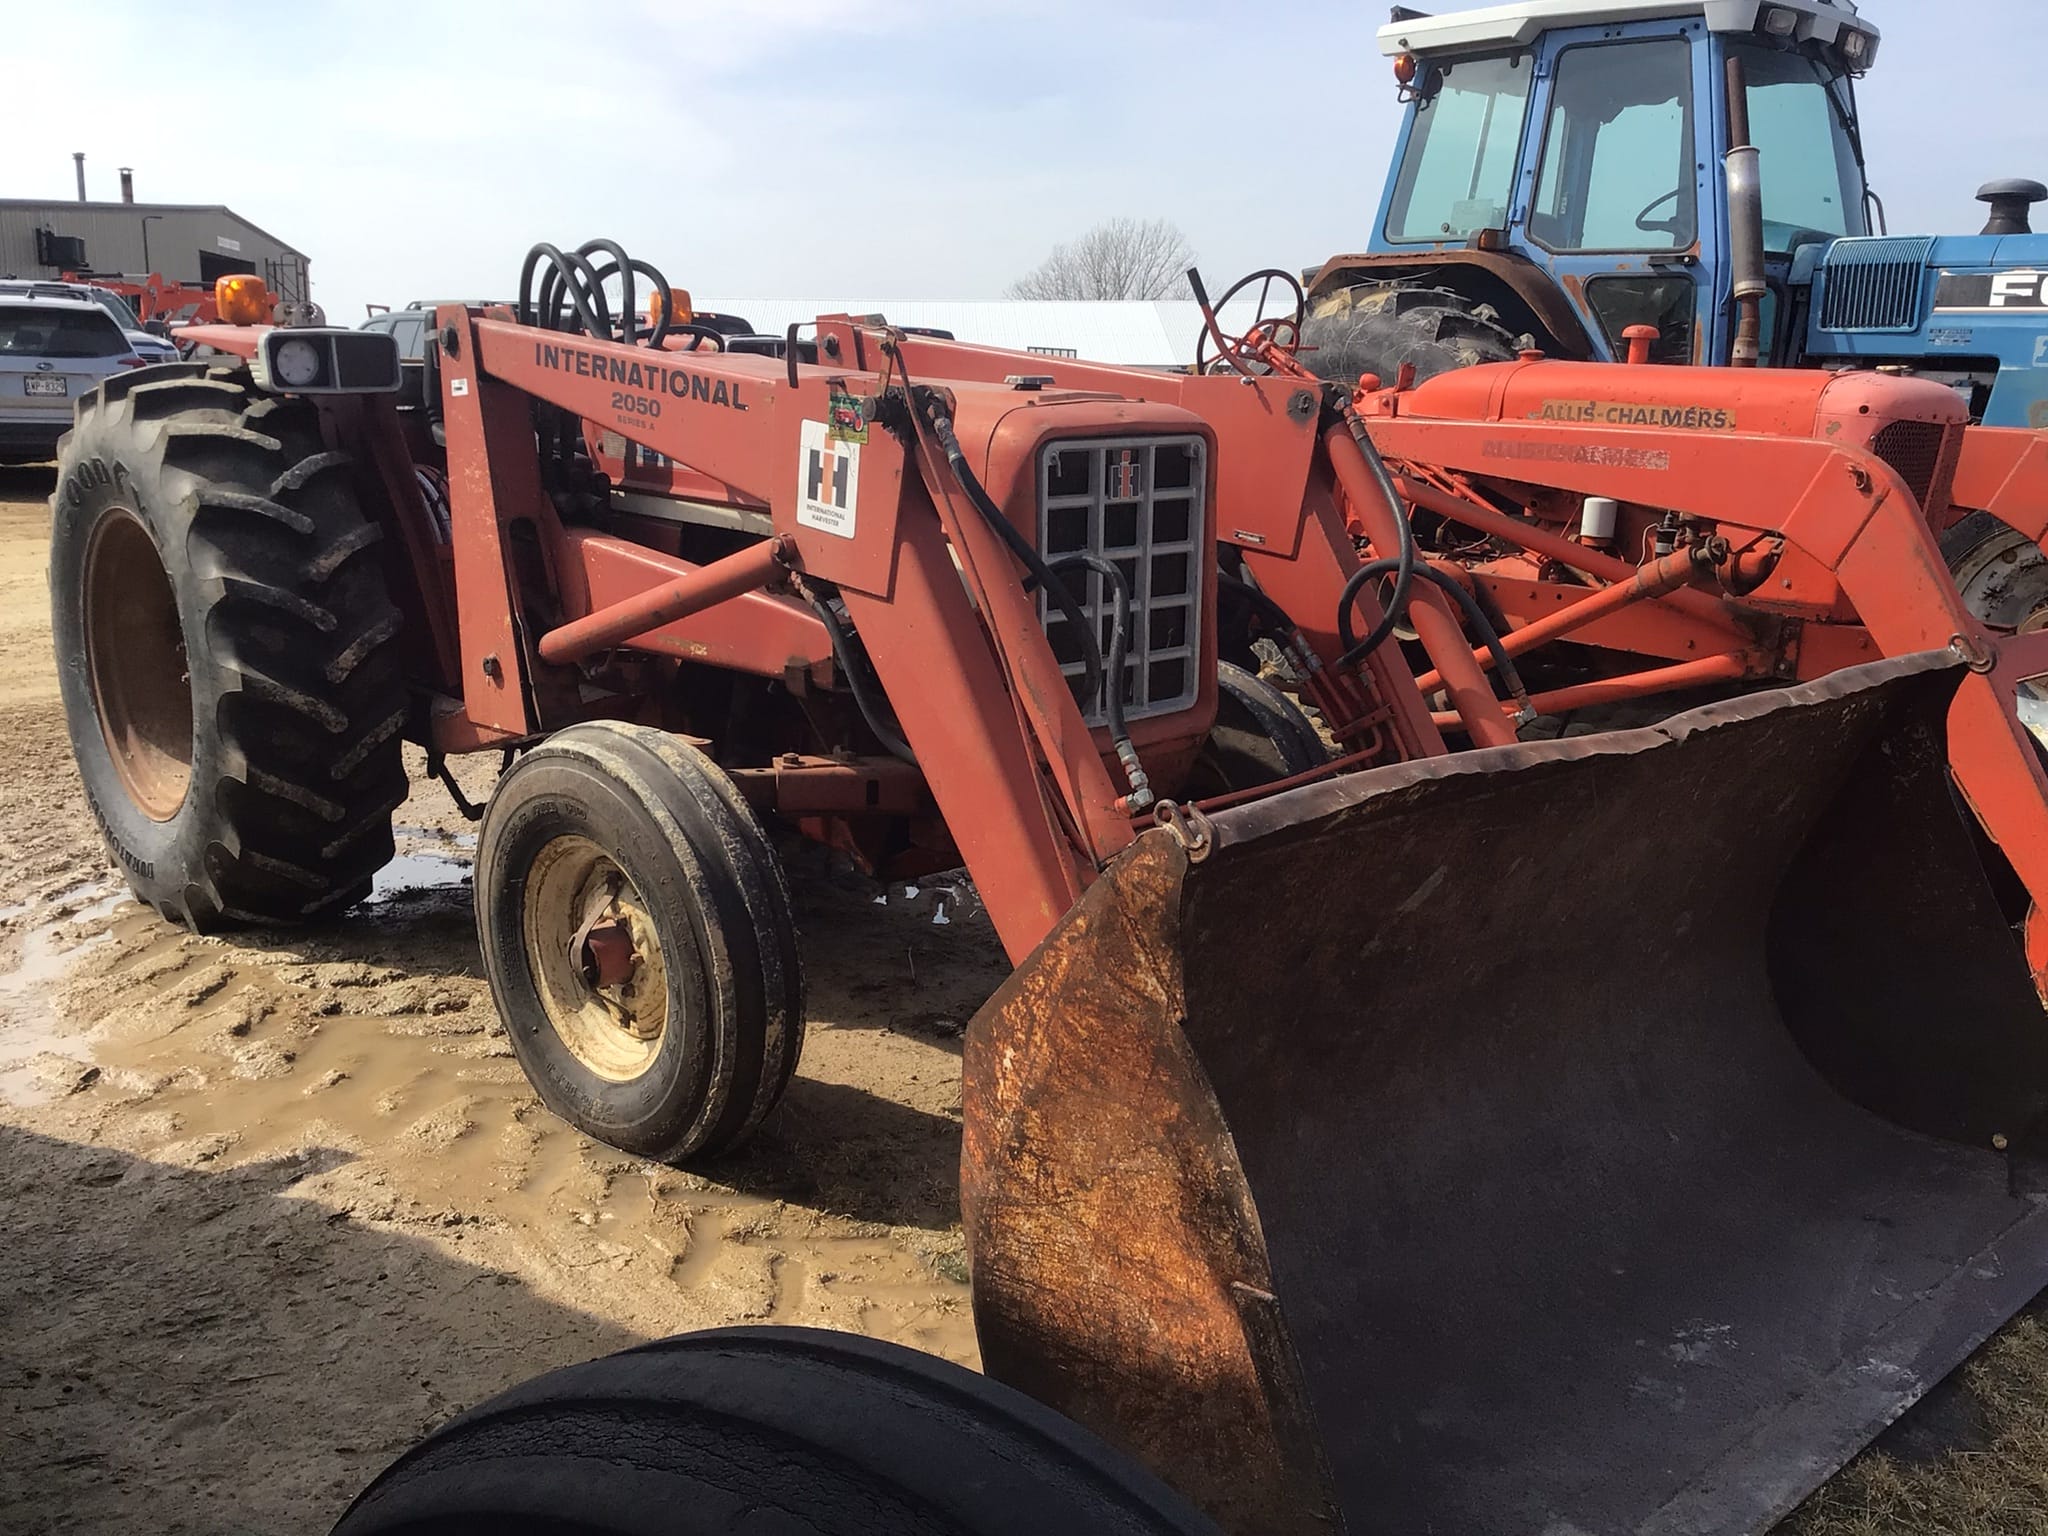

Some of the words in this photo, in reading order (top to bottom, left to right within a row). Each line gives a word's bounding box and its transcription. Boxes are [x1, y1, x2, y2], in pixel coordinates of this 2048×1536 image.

[536, 343, 748, 411] INTERNATIONAL
[611, 391, 661, 418] 2050
[1541, 402, 1728, 429] ALLIS-CHALMERS
[617, 415, 647, 429] SERIES
[648, 423, 656, 432] A
[806, 504, 846, 521] INTERNATIONAL
[812, 514, 839, 527] HARVESTER
